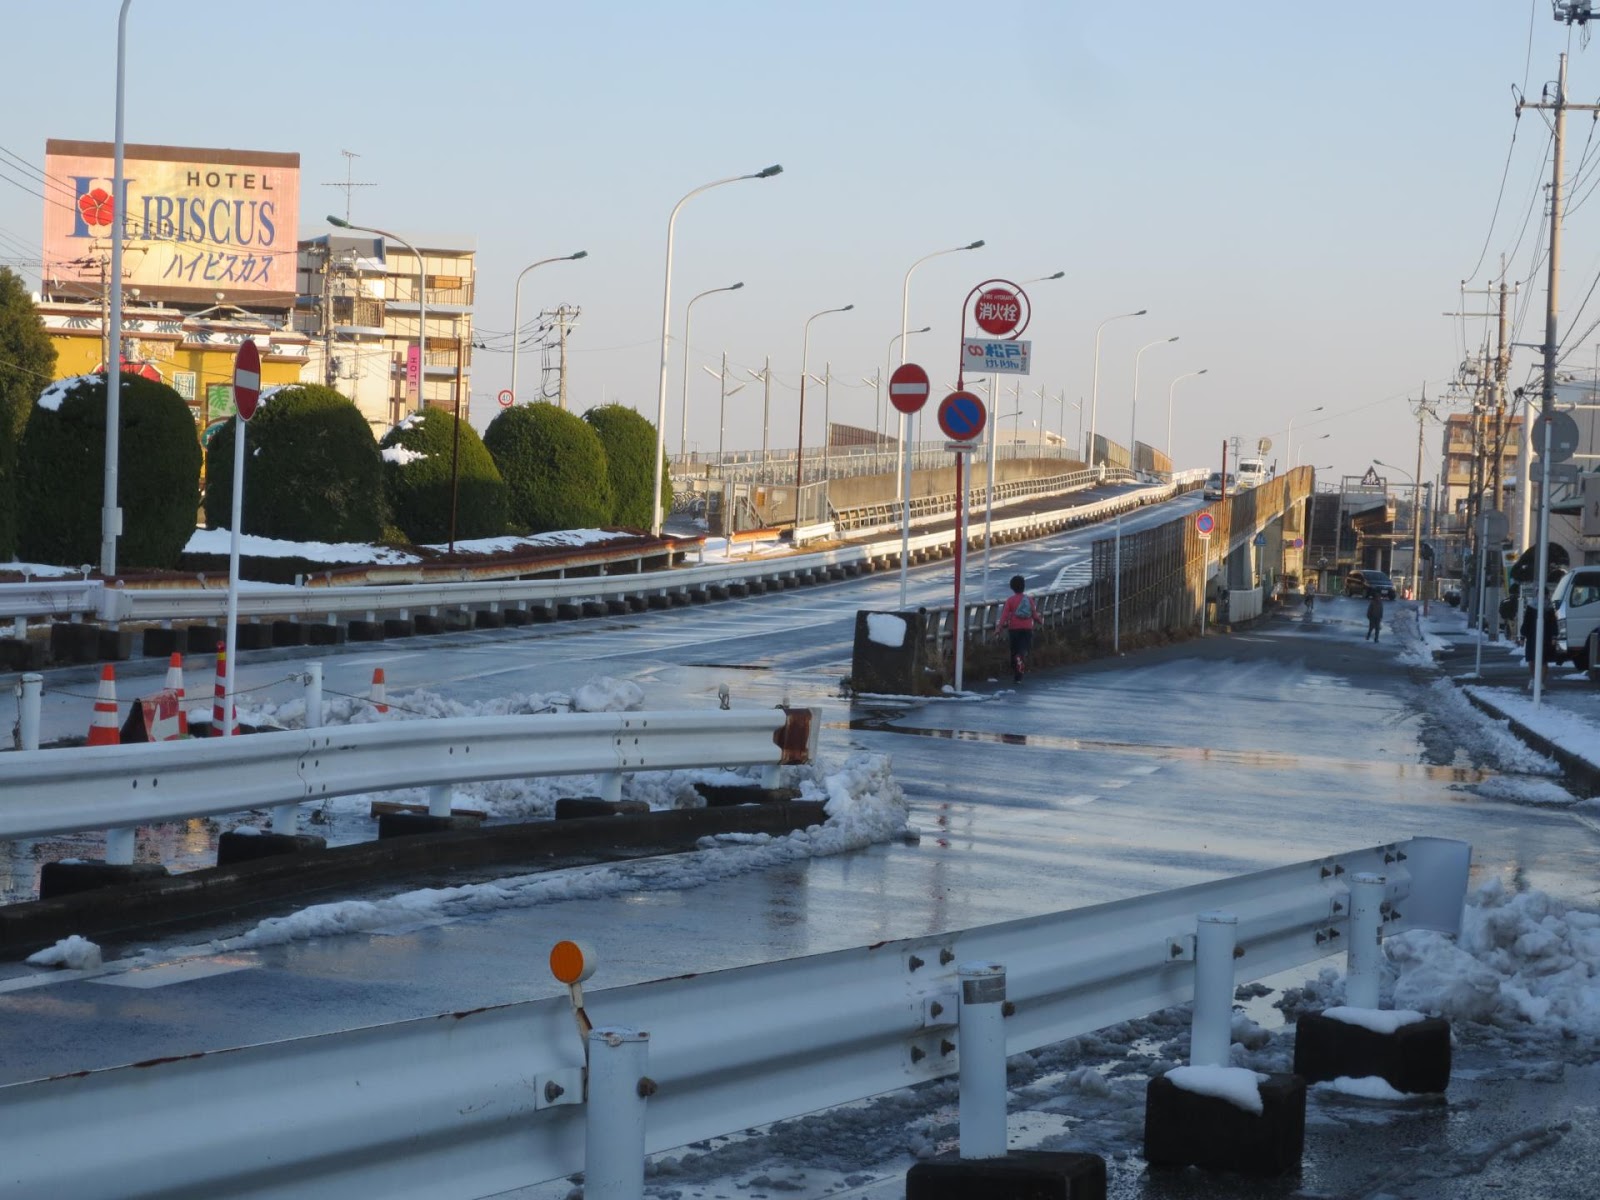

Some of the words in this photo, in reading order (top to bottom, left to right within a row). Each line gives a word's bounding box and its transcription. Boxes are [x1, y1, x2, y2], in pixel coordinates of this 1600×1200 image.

[187, 171, 273, 190] HOTEL
[163, 252, 273, 282] ハイビスカス
[979, 302, 1018, 322] 消火栓
[985, 343, 1021, 358] 松戸
[409, 357, 417, 394] HOTEL
